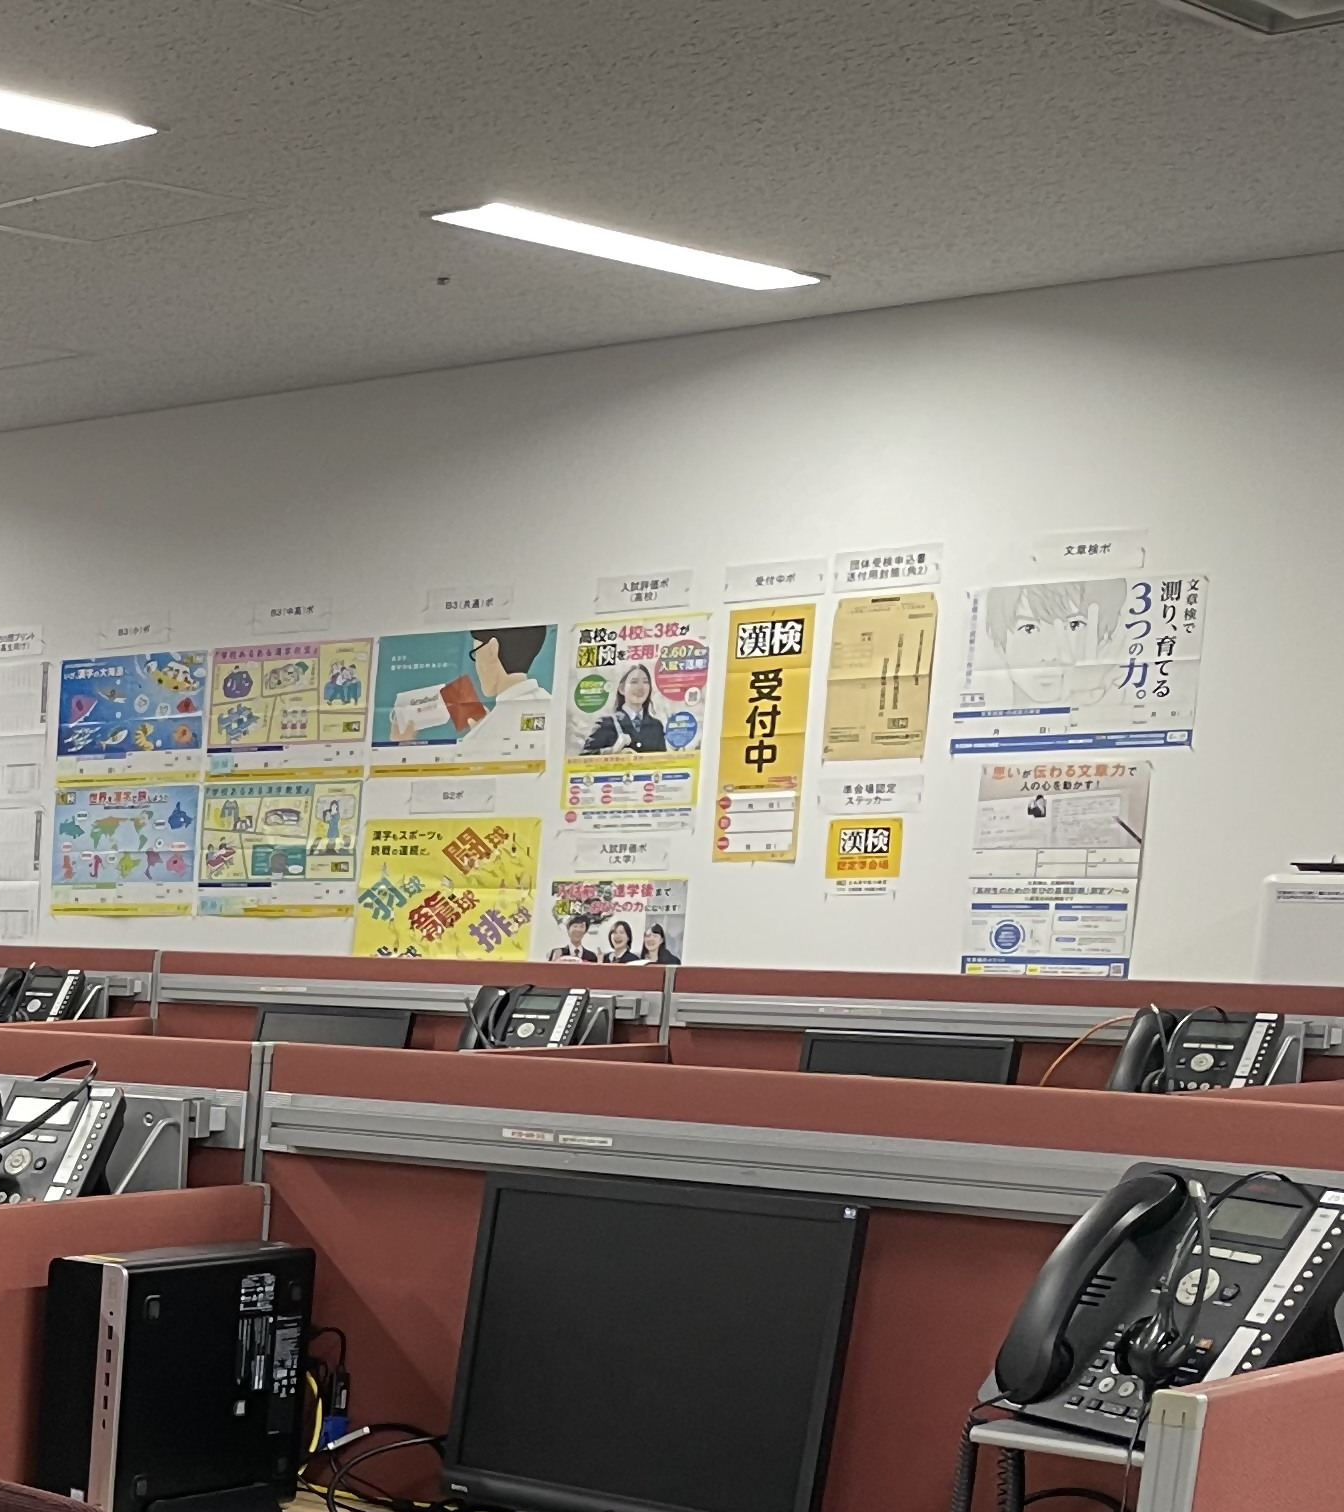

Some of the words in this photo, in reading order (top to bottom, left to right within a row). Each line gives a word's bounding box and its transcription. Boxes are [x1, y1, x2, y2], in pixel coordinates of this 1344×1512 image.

[579, 622, 690, 645] 高校の4校に3校が
[1183, 579, 1200, 634] 文章検で
[737, 618, 803, 658] 漢検
[1118, 582, 1152, 700] 3つの力。
[1152, 580, 1182, 698] 測り、育てる
[745, 668, 783, 773] 受付中
[841, 829, 890, 854] 漢検
